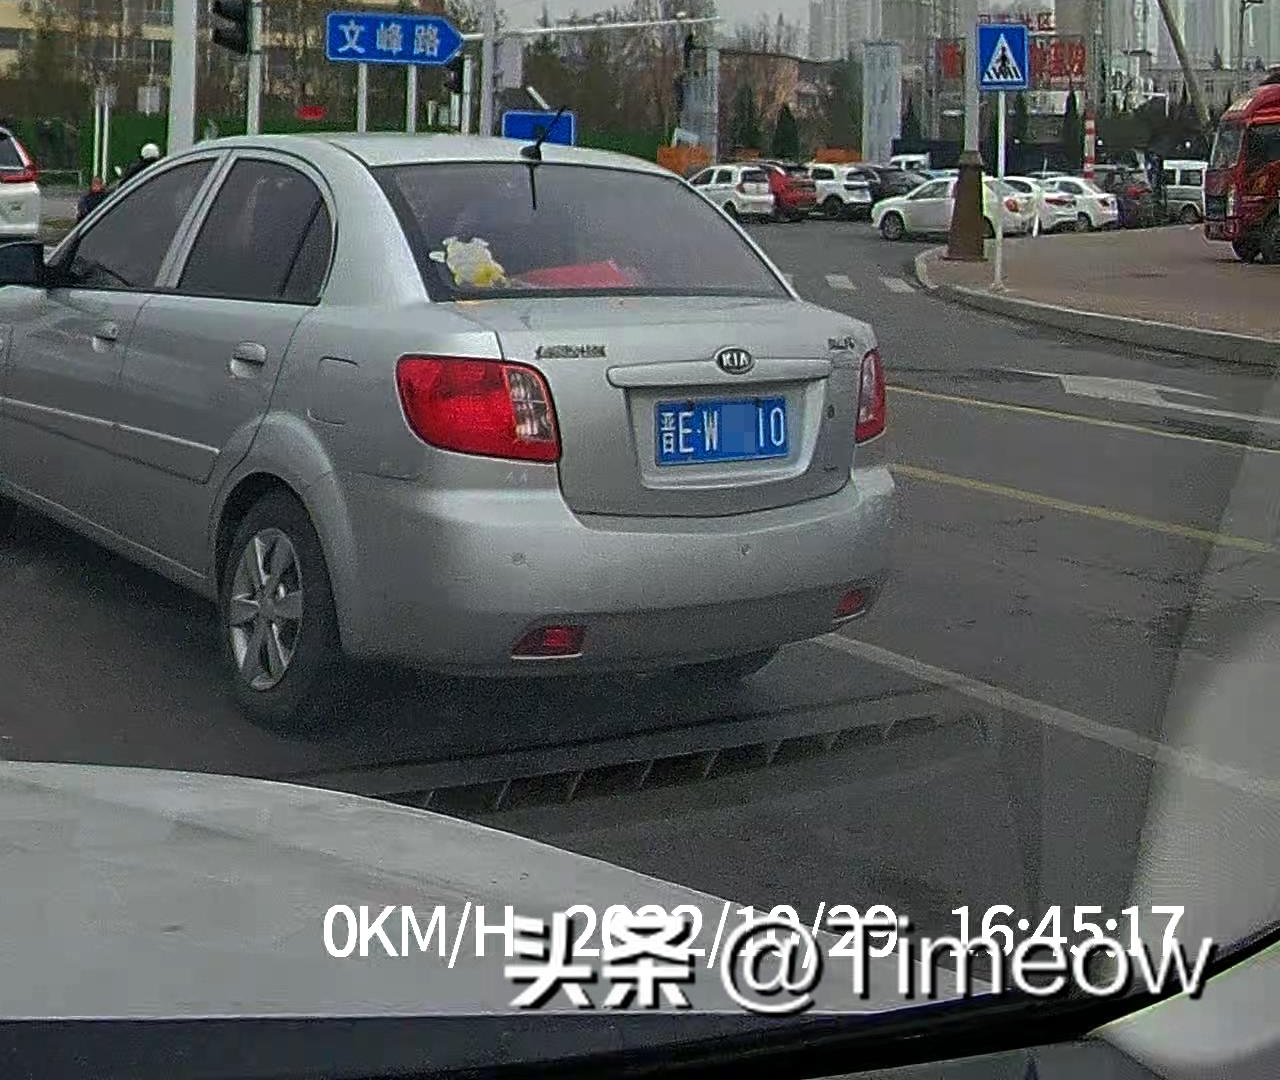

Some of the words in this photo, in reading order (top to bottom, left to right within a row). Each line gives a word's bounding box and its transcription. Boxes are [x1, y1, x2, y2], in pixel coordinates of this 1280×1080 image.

[338, 19, 439, 58] 文峰路
[721, 351, 750, 368] KIA
